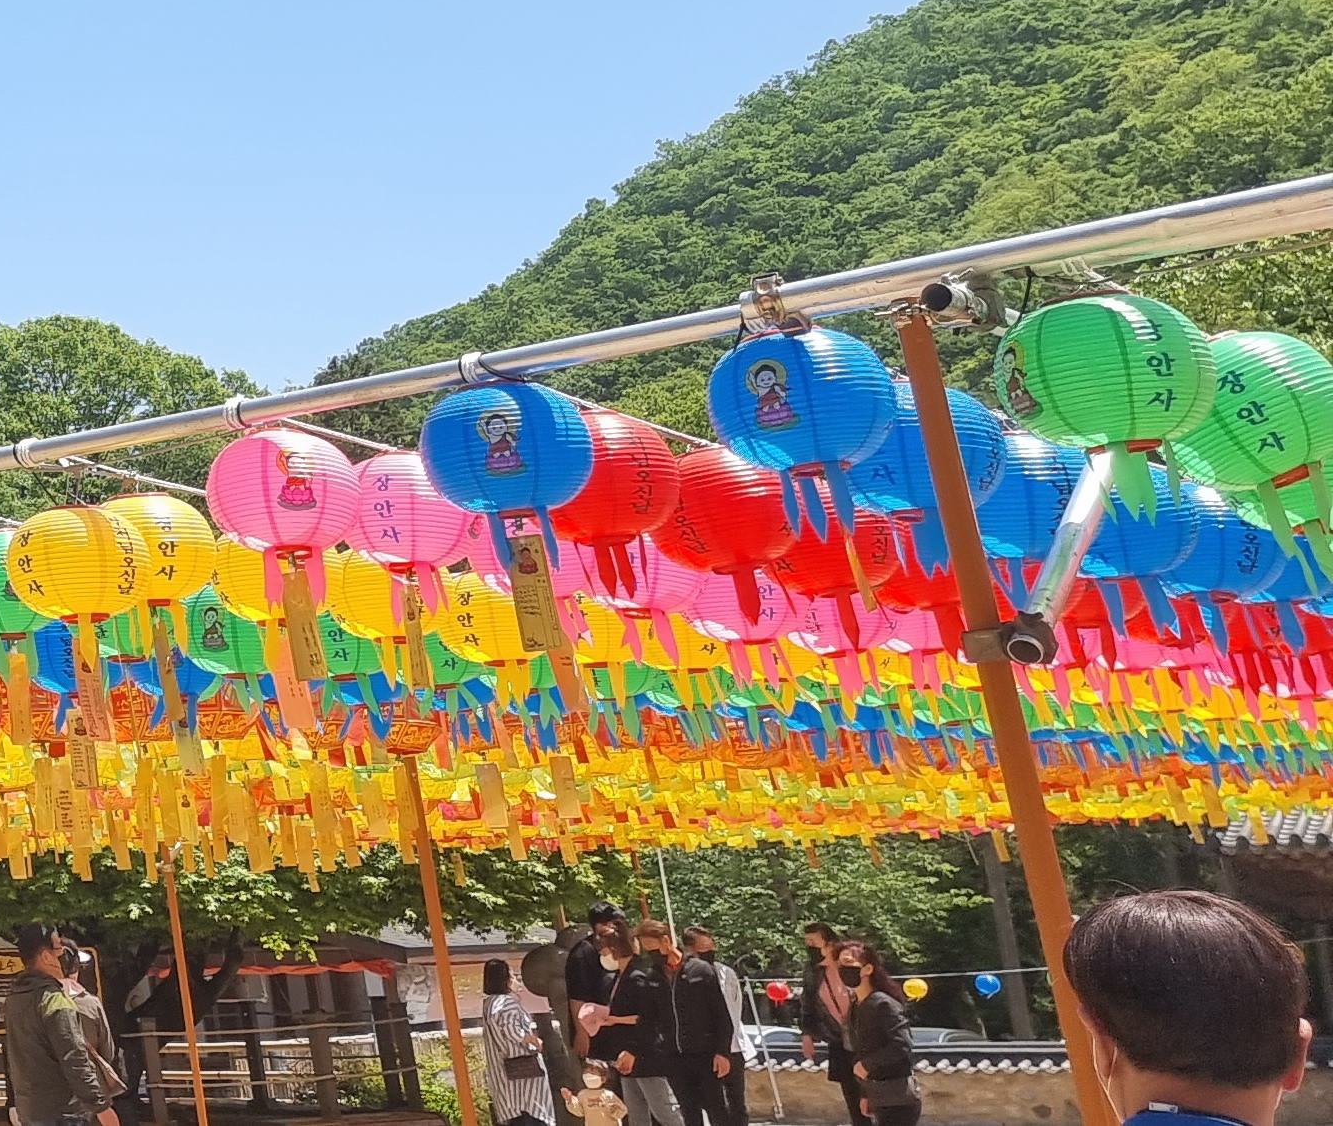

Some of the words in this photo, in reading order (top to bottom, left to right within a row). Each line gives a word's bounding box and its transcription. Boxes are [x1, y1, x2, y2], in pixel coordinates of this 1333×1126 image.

[1145, 318, 1179, 413] 장안사
[1217, 369, 1287, 454] 장안사
[372, 474, 403, 544] 장안사
[17, 530, 46, 597] 장안사
[456, 591, 481, 647] 장안사
